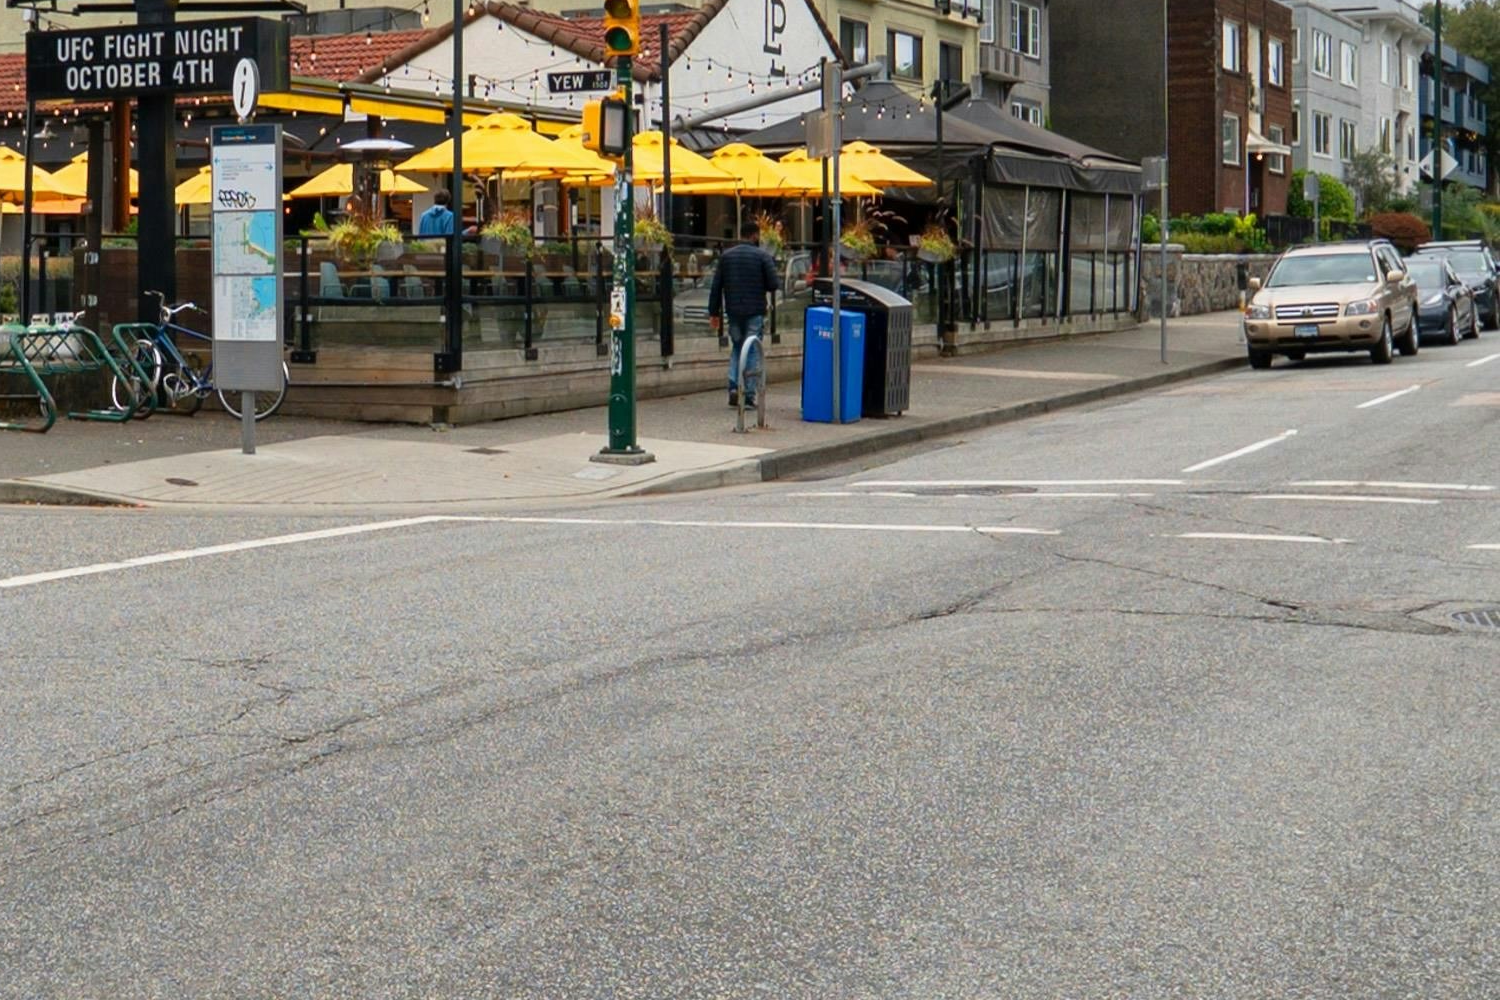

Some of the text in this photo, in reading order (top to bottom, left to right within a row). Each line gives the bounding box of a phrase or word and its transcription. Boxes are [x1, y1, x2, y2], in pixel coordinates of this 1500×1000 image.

[57, 25, 244, 63] UFC FIGHT NIGHT
[65, 58, 214, 92] OCTOBER 4TH
[552, 74, 584, 91] YEW
